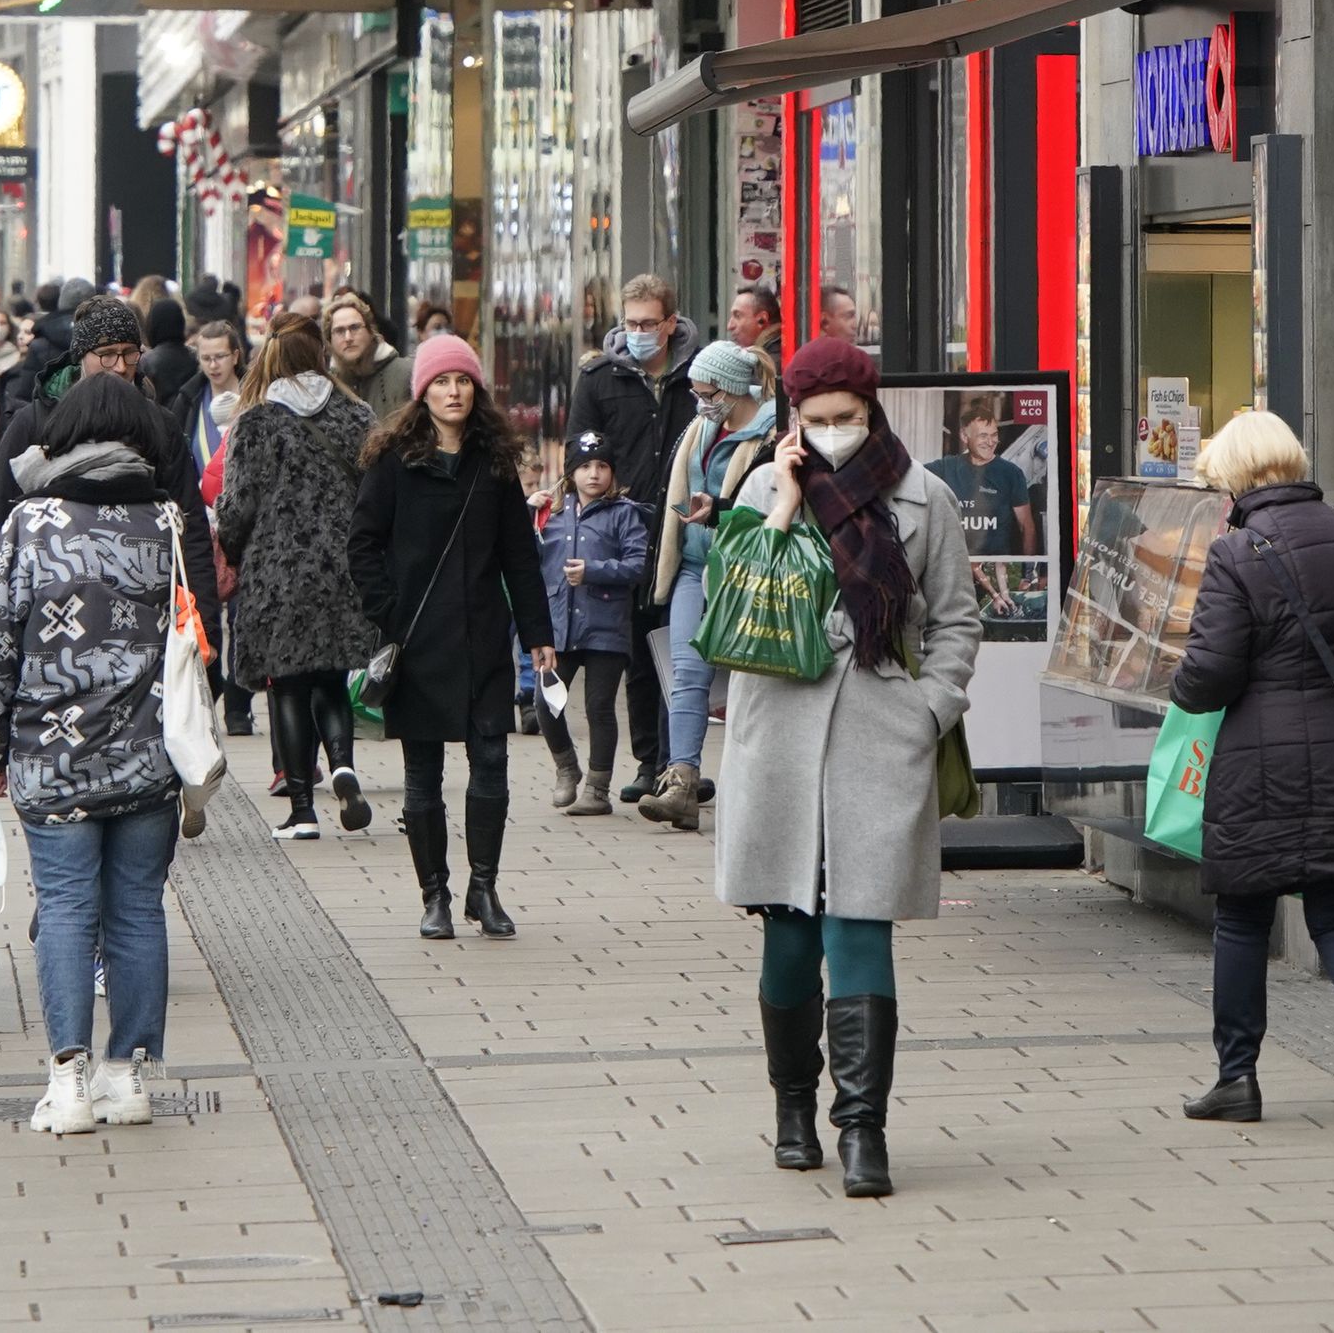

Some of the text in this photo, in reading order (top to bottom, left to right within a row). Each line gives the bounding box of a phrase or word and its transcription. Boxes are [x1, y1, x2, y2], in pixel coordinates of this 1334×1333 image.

[1020, 399, 1042, 407] WEIN
[1151, 390, 1163, 402] Fish
[1168, 389, 1185, 405] Chips
